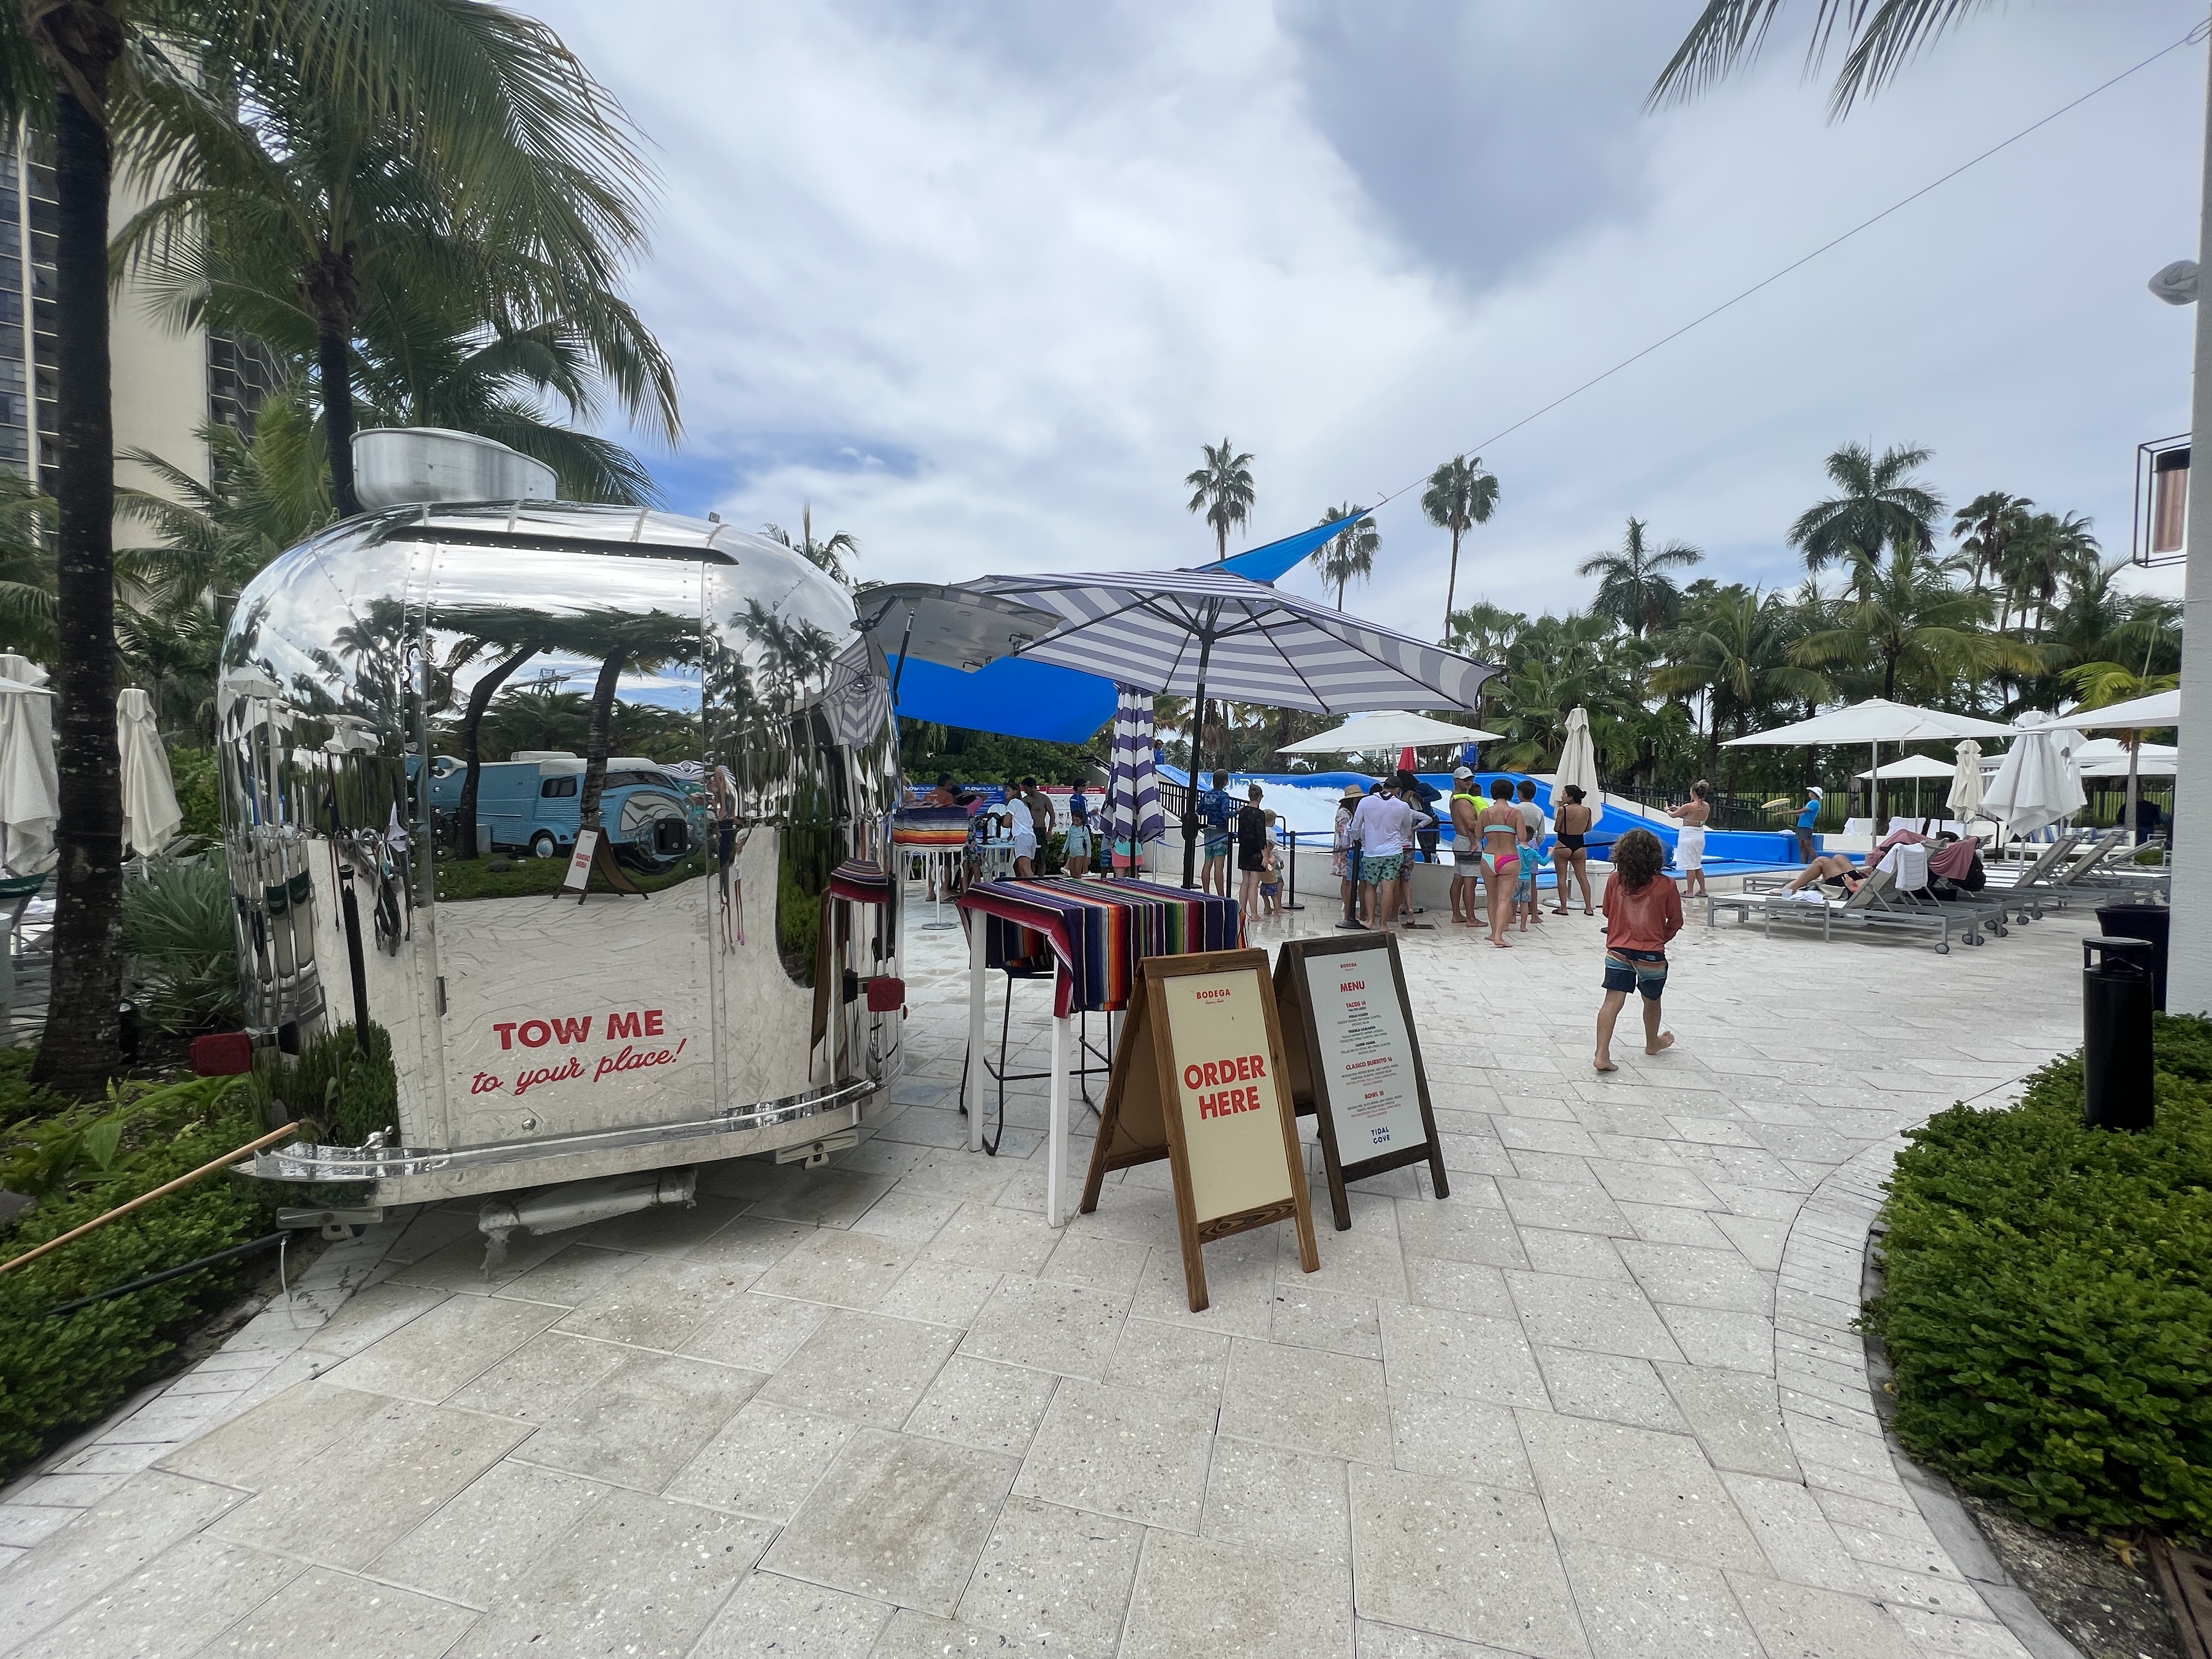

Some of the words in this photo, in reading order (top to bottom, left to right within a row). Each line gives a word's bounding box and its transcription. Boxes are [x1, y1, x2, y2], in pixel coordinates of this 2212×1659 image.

[1196, 989, 1231, 999] BODEGA
[1340, 980, 1365, 992] MENU
[493, 1016, 592, 1050] TOW
[607, 1009, 664, 1040] ME
[471, 1071, 504, 1094] to
[515, 1057, 585, 1096] your
[594, 1038, 687, 1082] place!
[1184, 1055, 1267, 1090] ORDER
[1346, 1062, 1367, 1070] CLASICO
[1367, 1057, 1387, 1066] BURRITO
[1198, 1086, 1261, 1120] HERE
[1371, 1126, 1389, 1136] TIDAL
